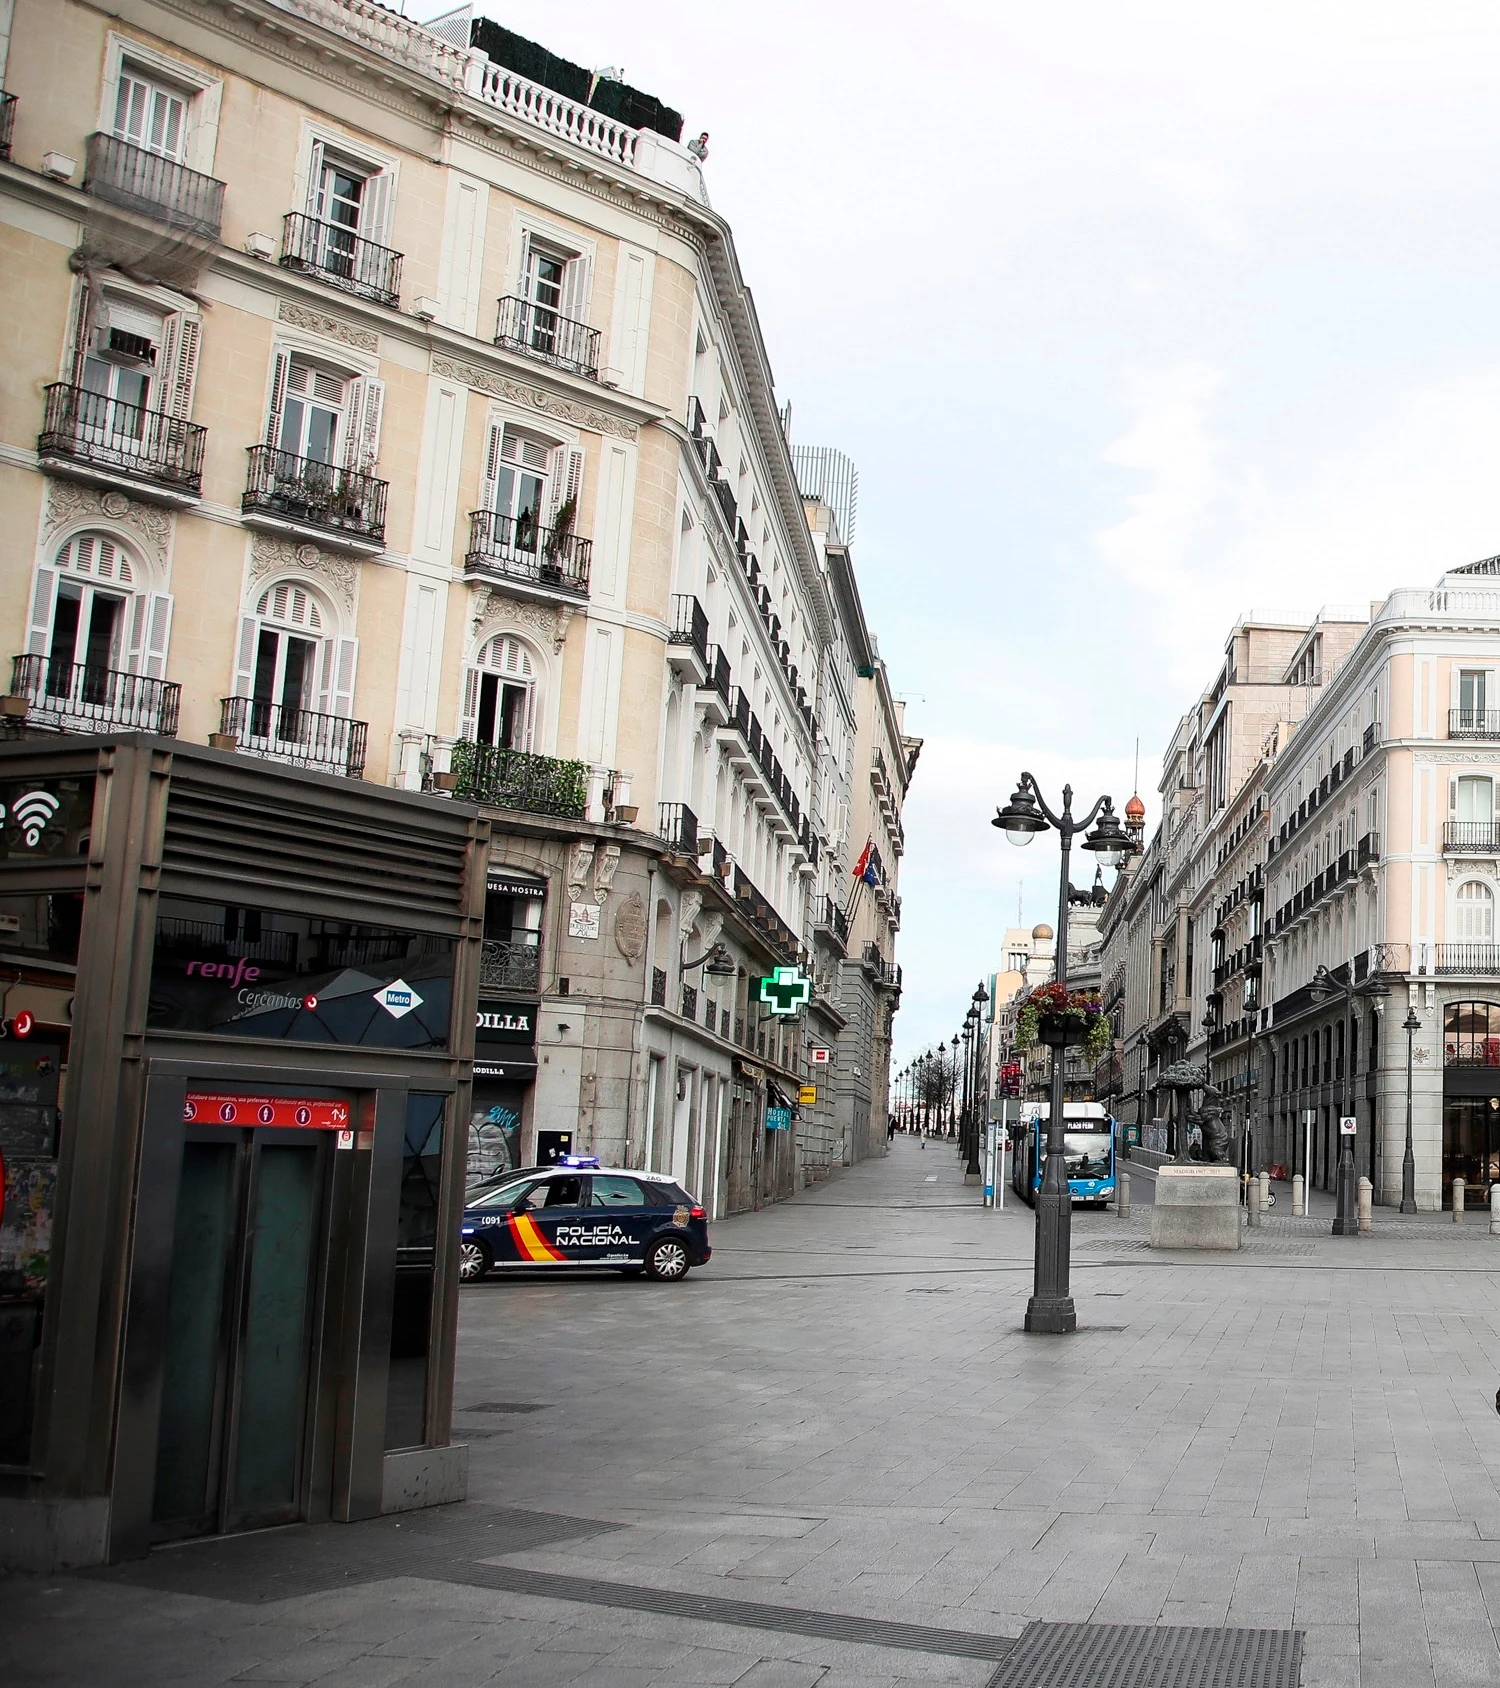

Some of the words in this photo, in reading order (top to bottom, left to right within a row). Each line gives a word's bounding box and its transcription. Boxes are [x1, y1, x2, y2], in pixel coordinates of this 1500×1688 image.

[511, 886, 544, 896] NOSTRA
[186, 957, 261, 988] renfe
[237, 988, 303, 1010] Cercanías
[387, 994, 410, 1004] Metro
[485, 1216, 500, 1225] 091
[556, 1224, 622, 1236] POLICÍA
[556, 1235, 640, 1246] NACIONAL
